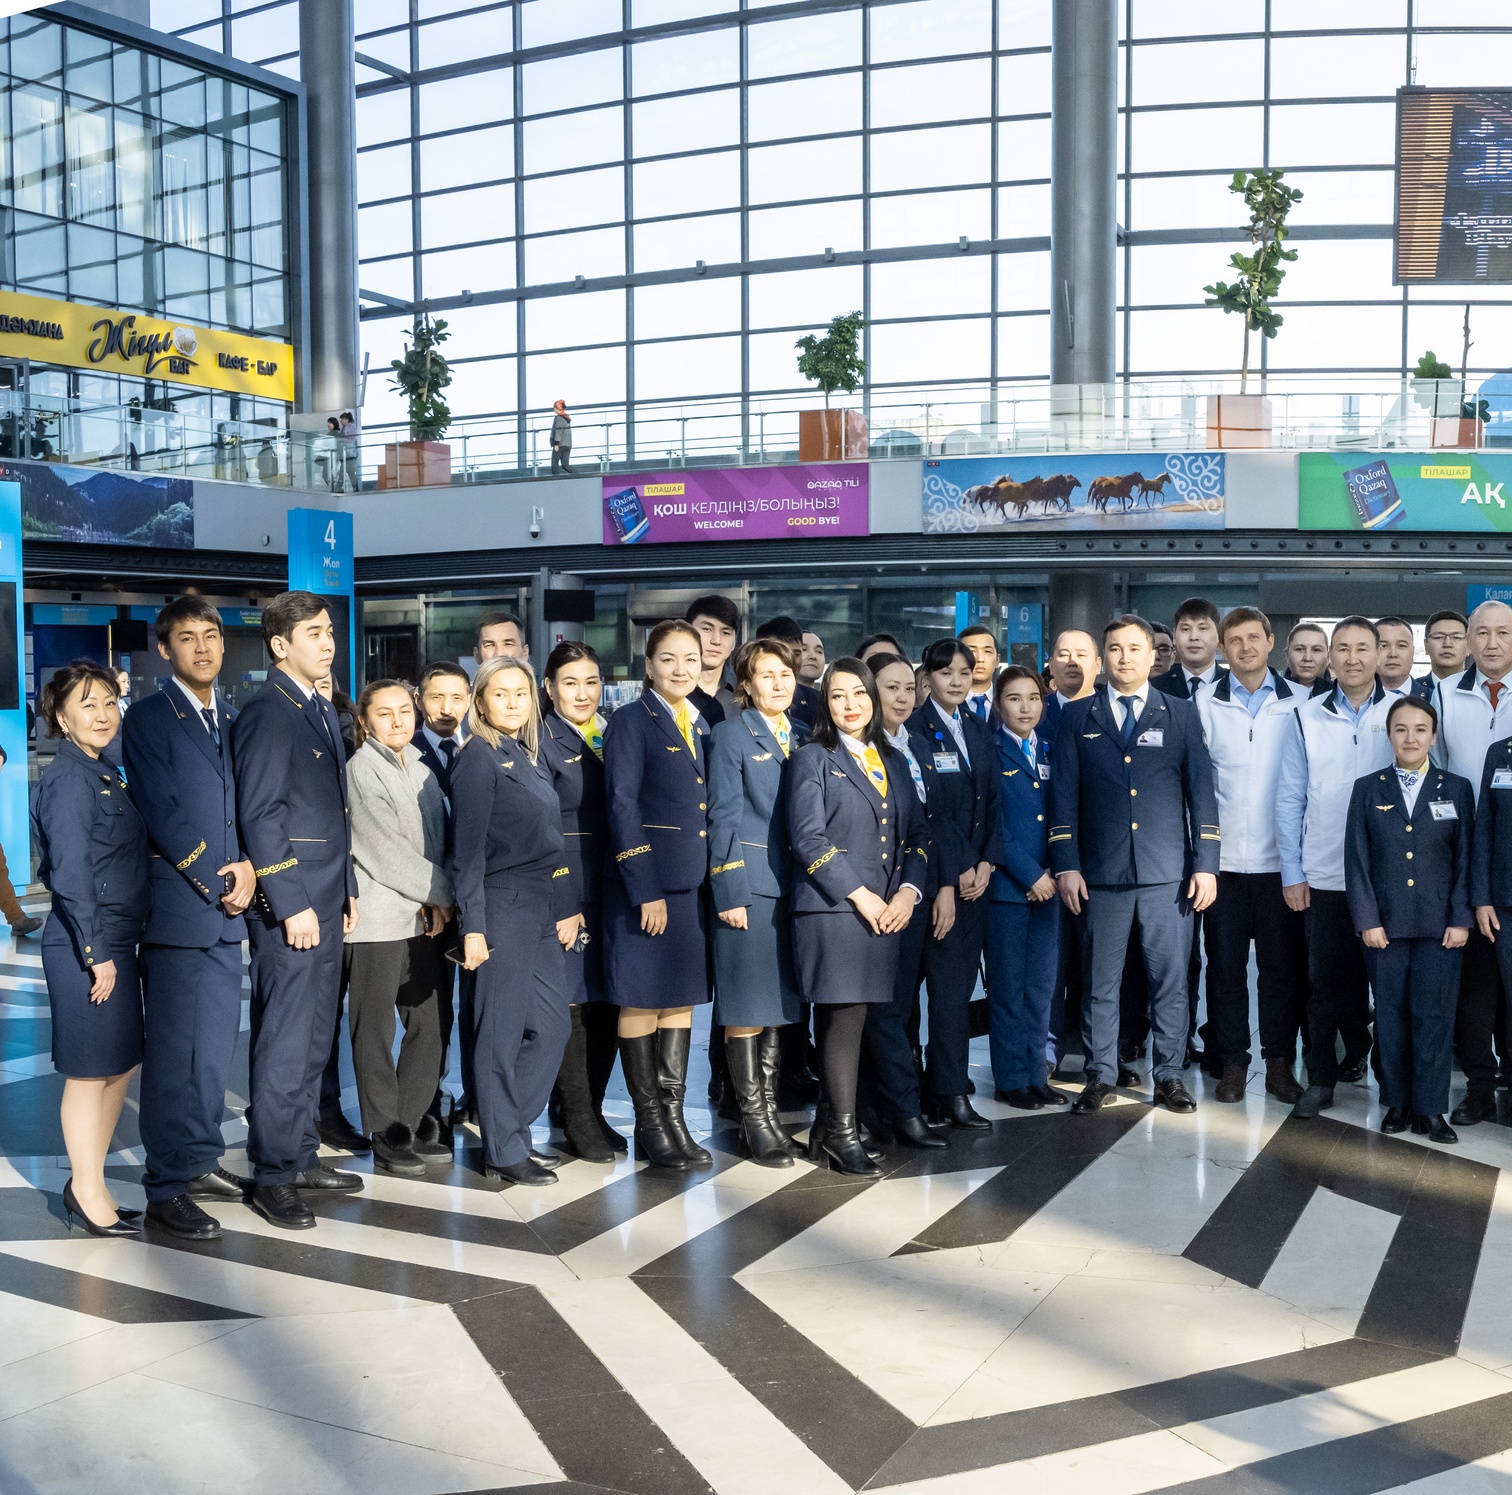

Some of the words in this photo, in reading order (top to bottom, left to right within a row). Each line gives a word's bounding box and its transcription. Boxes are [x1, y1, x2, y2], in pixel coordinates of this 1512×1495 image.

[218, 352, 249, 372] КАФЕ
[257, 360, 278, 376] БАР
[1354, 465, 1387, 484] Oxford
[1424, 468, 1468, 476] ТІЛАШАР
[646, 486, 683, 495] ТІЛАШАР
[807, 479, 842, 490] QAZAQ
[844, 479, 860, 488] TILI
[1358, 479, 1388, 496] Qazaq
[613, 491, 637, 507] Oxford
[1460, 482, 1506, 509] АҚ
[616, 502, 638, 516] Qazaq
[653, 503, 687, 518] ҚОШ
[691, 497, 840, 515] КЕЛДІҢІЗ/БОЛЫҢЫЗ!
[693, 519, 744, 529] WELCOME!
[787, 517, 817, 526] GOOD
[818, 516, 840, 525] BYE!
[323, 519, 337, 550] 4
[1020, 606, 1030, 622] 6
